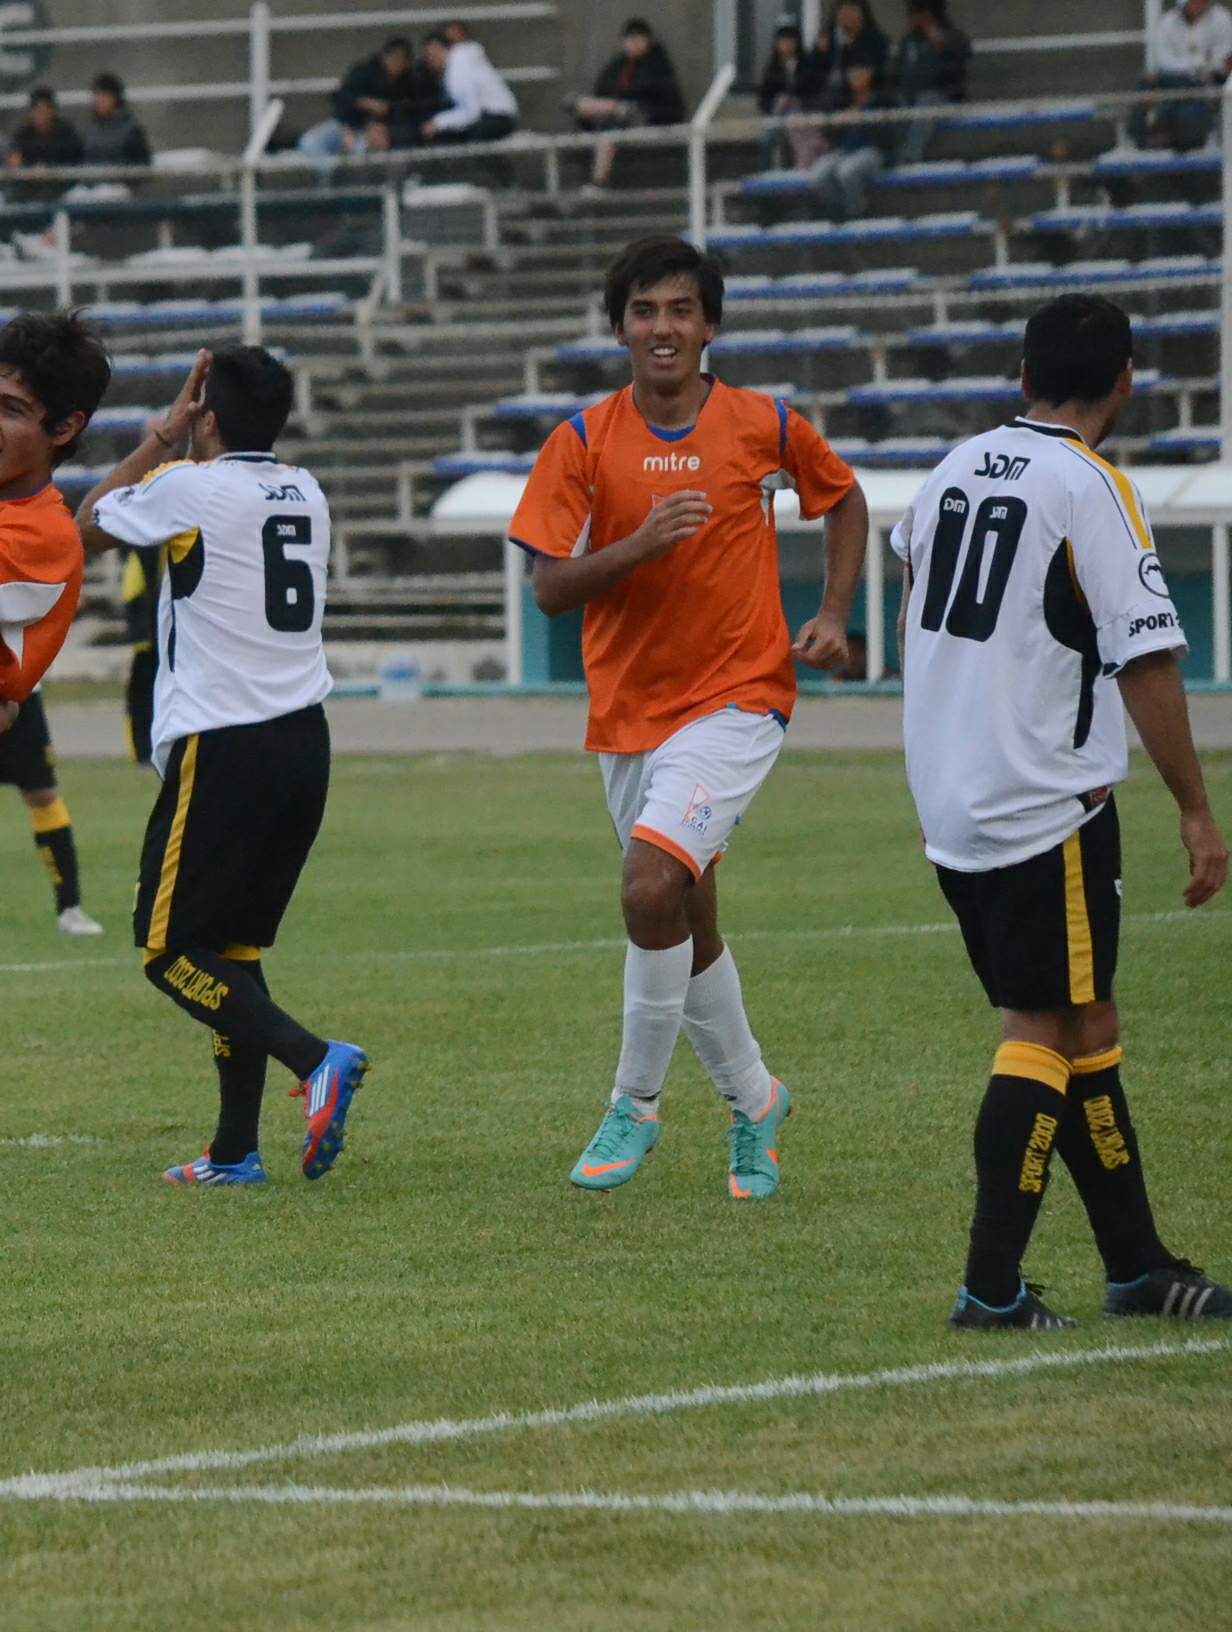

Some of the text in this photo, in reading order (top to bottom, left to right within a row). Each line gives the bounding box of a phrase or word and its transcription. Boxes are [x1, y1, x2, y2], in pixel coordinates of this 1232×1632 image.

[643, 452, 701, 472] mitre
[261, 514, 315, 632] 6
[920, 486, 1028, 643] 10
[1018, 1112, 1058, 1193] SPORT 2000
